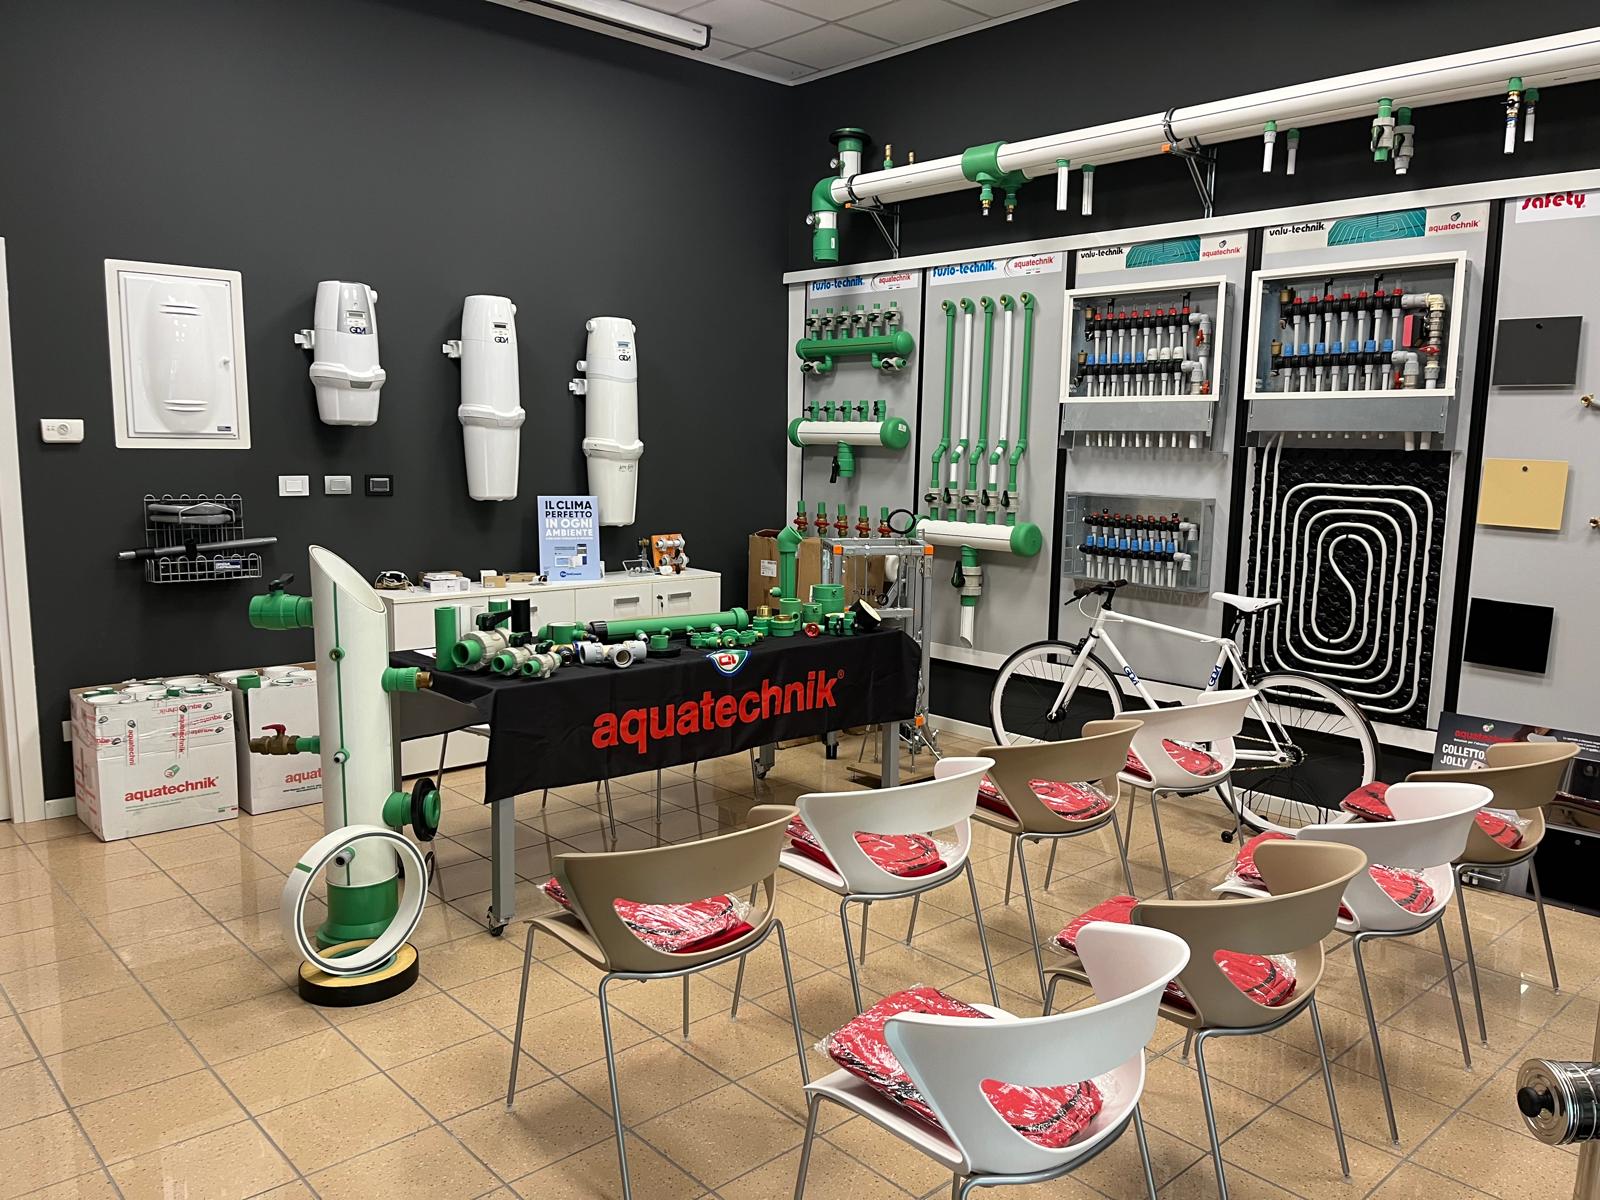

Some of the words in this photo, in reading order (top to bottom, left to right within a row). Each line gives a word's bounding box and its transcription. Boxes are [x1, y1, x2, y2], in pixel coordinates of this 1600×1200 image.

[1521, 191, 1586, 210] safety
[1428, 220, 1479, 233] aquatechnik
[1202, 247, 1240, 257] aquatechnik
[1013, 256, 1054, 269] aquatechnik
[879, 273, 911, 285] aquatechnik
[545, 500, 554, 510] IL
[556, 500, 592, 510] CLIMA
[545, 518, 558, 528] IN
[560, 518, 593, 528] OGNI
[545, 529, 593, 537] AMBIENTE
[1440, 755, 1468, 768] JOLLY
[124, 776, 217, 802] aquatechnik
